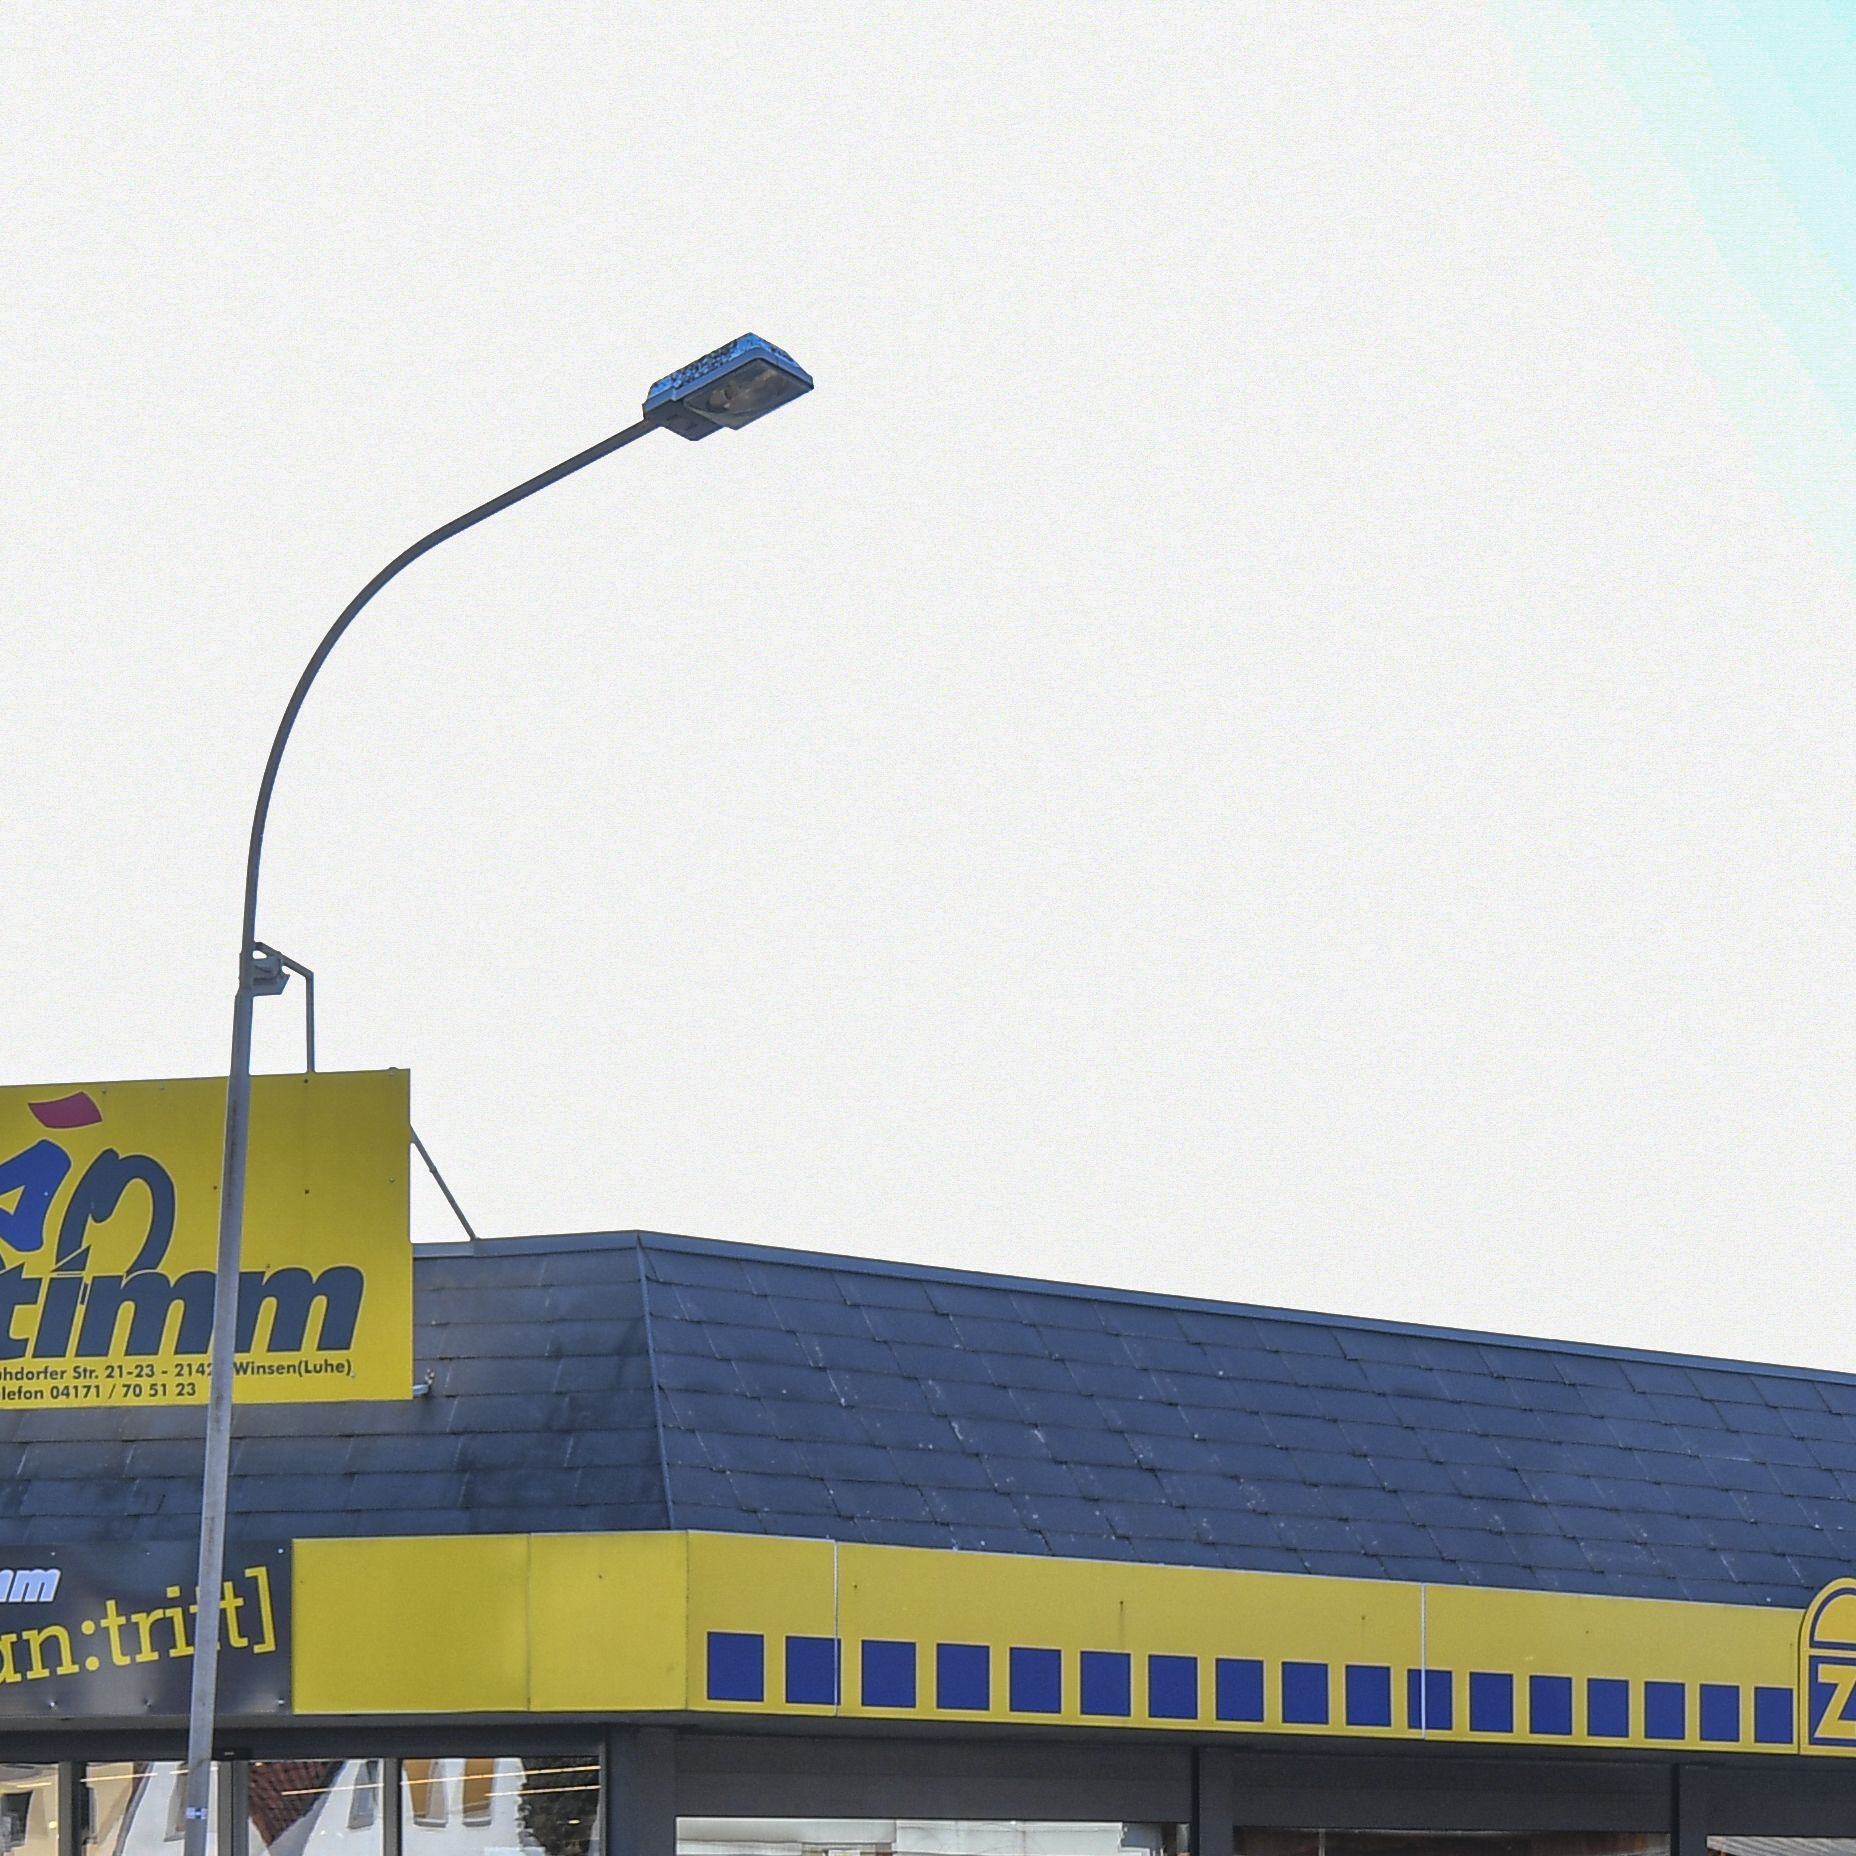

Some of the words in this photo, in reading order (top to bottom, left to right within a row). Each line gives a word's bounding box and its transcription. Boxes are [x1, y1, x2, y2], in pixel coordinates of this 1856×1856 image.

[72, 1364, 99, 1381] Str.
[104, 1363, 155, 1380] 21-23
[233, 1359, 352, 1378] Winsen(Luhe)
[50, 1384, 101, 1399] 04171
[107, 1383, 117, 1400] /
[122, 1383, 143, 1398] 70
[148, 1383, 168, 1397] 51
[176, 1382, 196, 1397] 23
